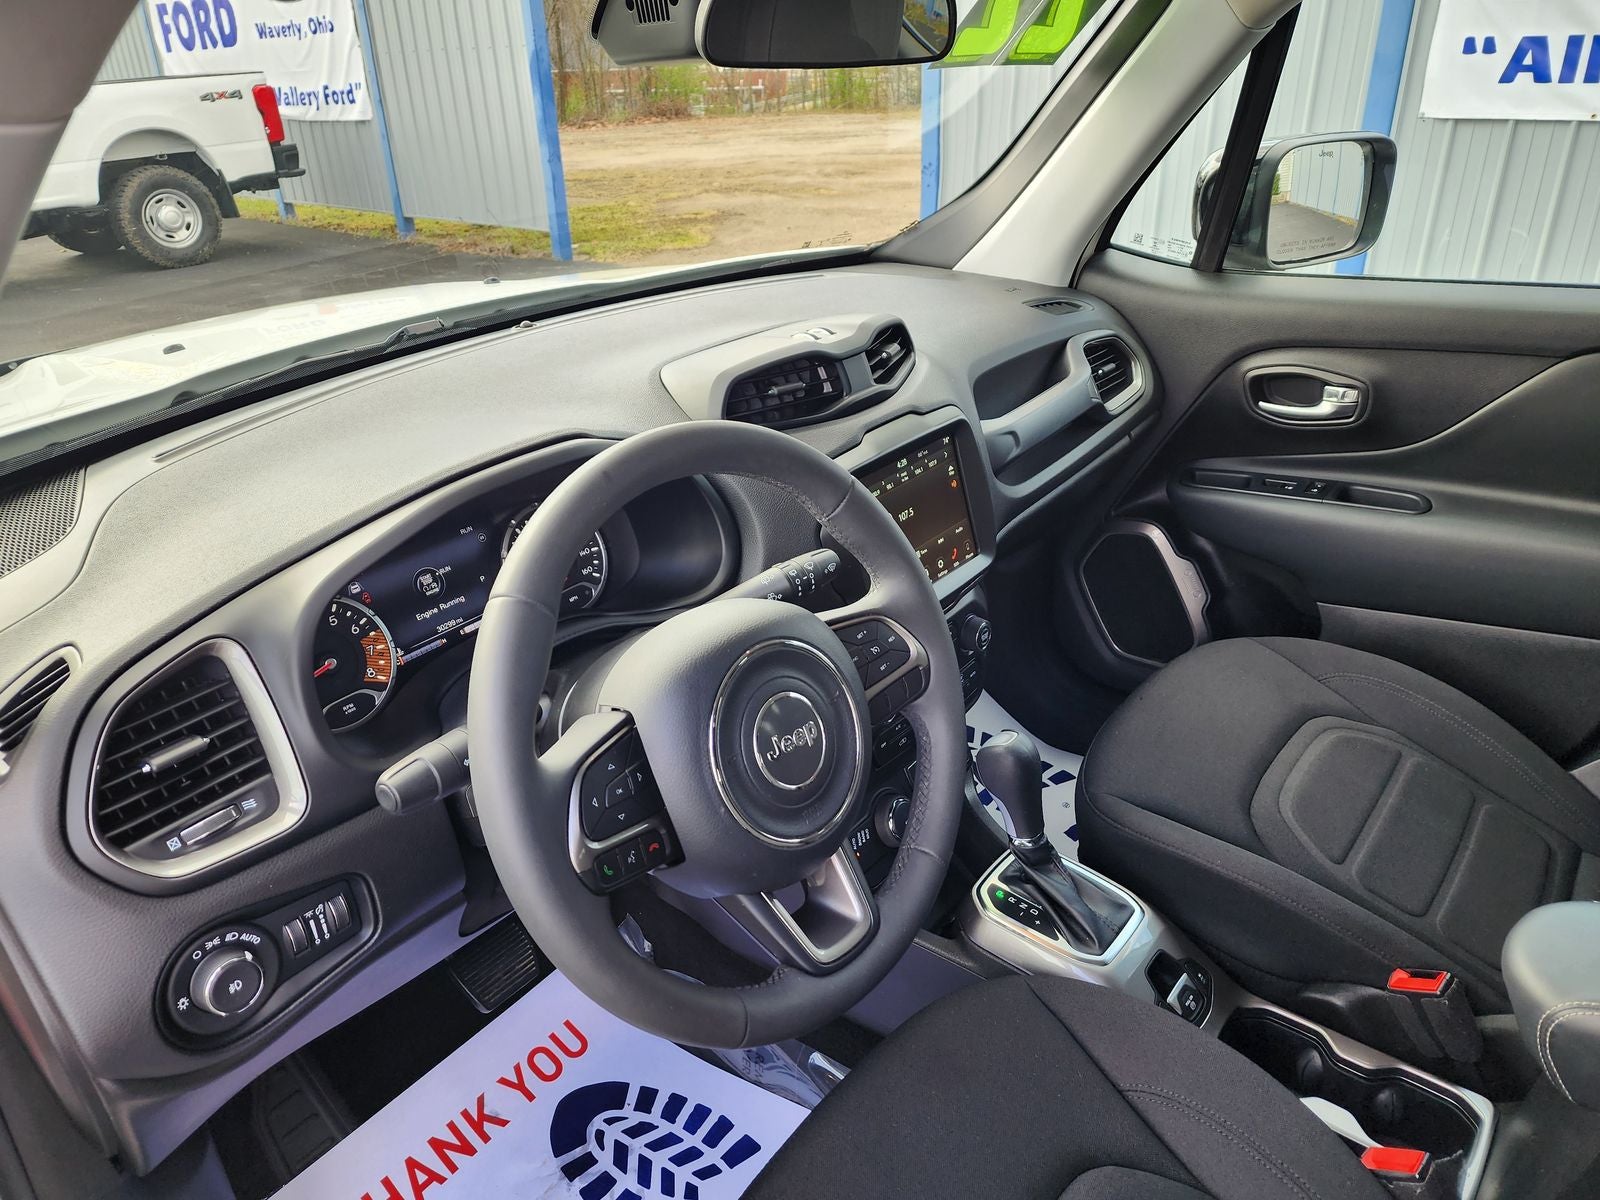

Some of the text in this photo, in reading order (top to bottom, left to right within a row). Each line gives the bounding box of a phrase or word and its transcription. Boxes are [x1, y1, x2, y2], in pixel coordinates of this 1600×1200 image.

[156, 0, 238, 53] FORD
[308, 15, 334, 36] Ohio
[322, 82, 361, 106] Ford"
[898, 507, 914, 522] 107.5
[460, 525, 473, 536] RUN
[438, 565, 452, 575] RUN
[581, 565, 593, 576] 160
[479, 575, 486, 583] P
[416, 595, 466, 622] Engine Running
[328, 615, 338, 626] 5
[436, 619, 457, 633] 30299
[351, 624, 360, 635] 6
[366, 645, 374, 656] 7
[366, 667, 376, 678] 8
[342, 703, 354, 712] RPM
[767, 720, 818, 762] Jeep
[1007, 896, 1018, 904] R
[1018, 902, 1028, 910] N
[1029, 908, 1039, 916] D
[239, 932, 261, 946] AUTO
[496, 1019, 589, 1103] YOU
